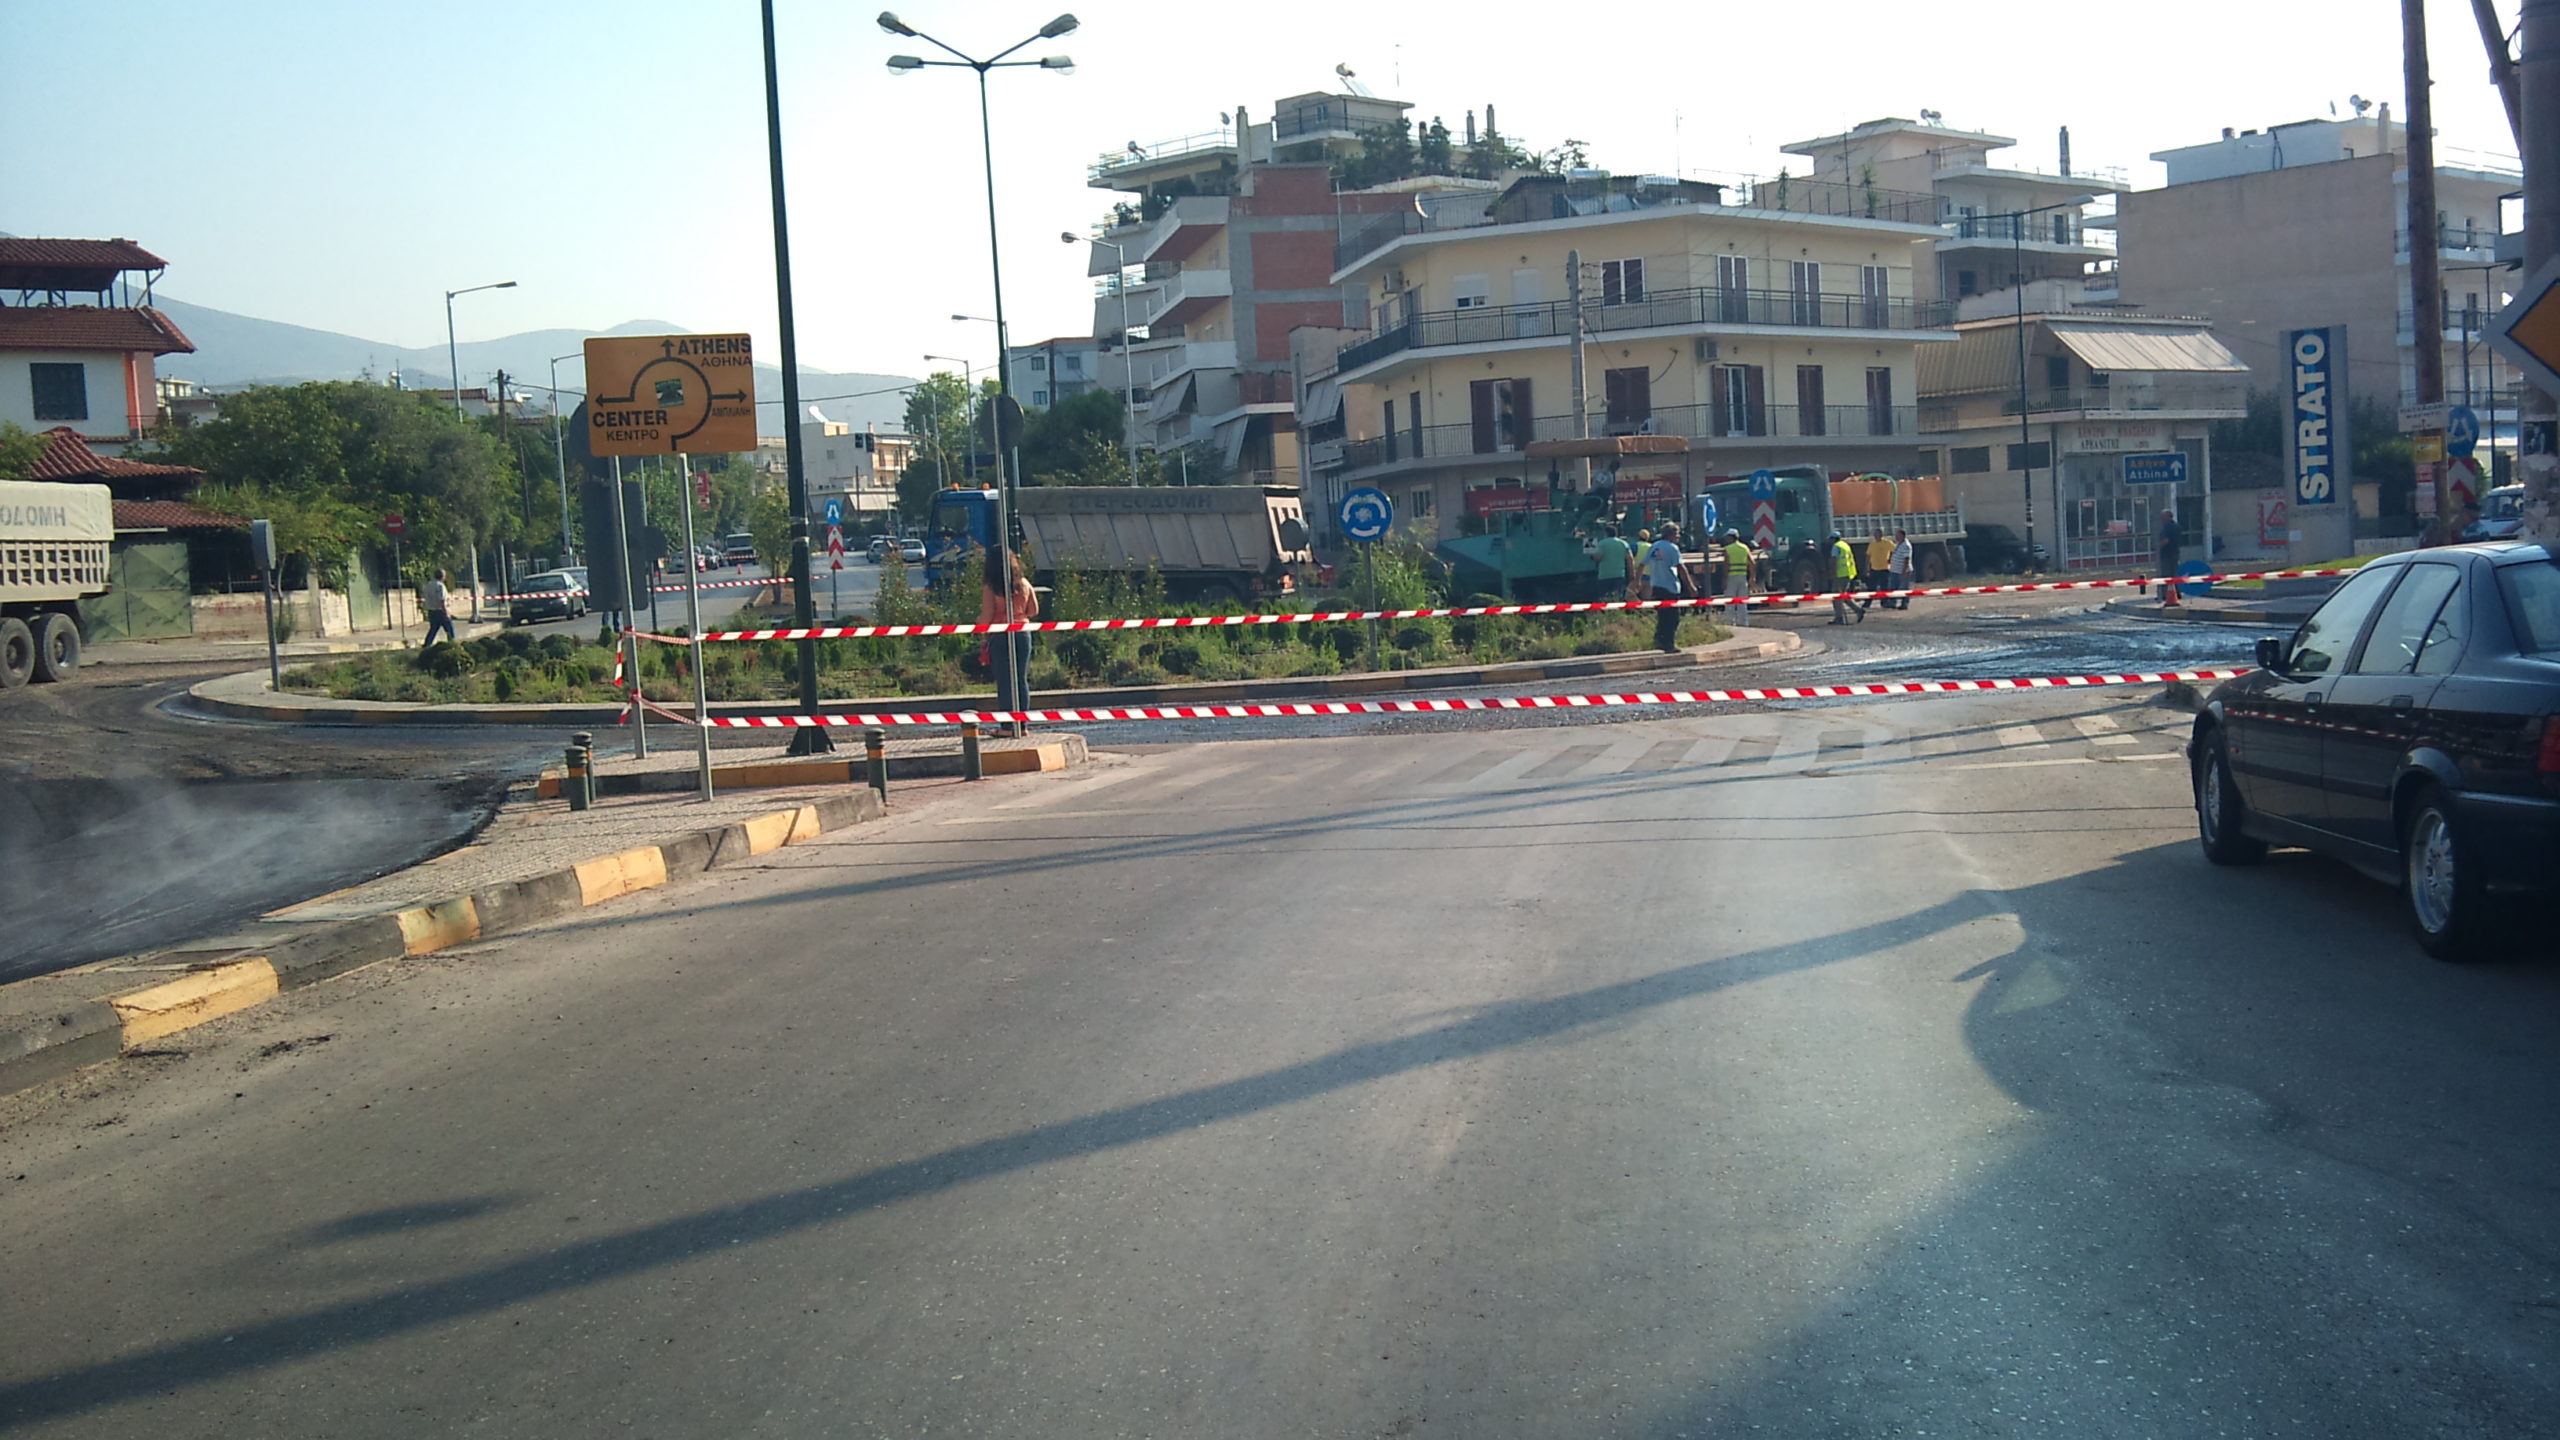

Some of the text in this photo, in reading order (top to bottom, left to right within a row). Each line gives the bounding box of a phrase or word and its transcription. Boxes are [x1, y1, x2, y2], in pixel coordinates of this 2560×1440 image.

[677, 338, 752, 355] ATHENS
[701, 356, 752, 367] ΑΘΗΝΑ
[592, 410, 668, 428] CENTER
[2294, 333, 2330, 499] STRATO
[606, 429, 659, 442] ΚΕΝΤΡΟ
[2129, 469, 2169, 480] Athina
